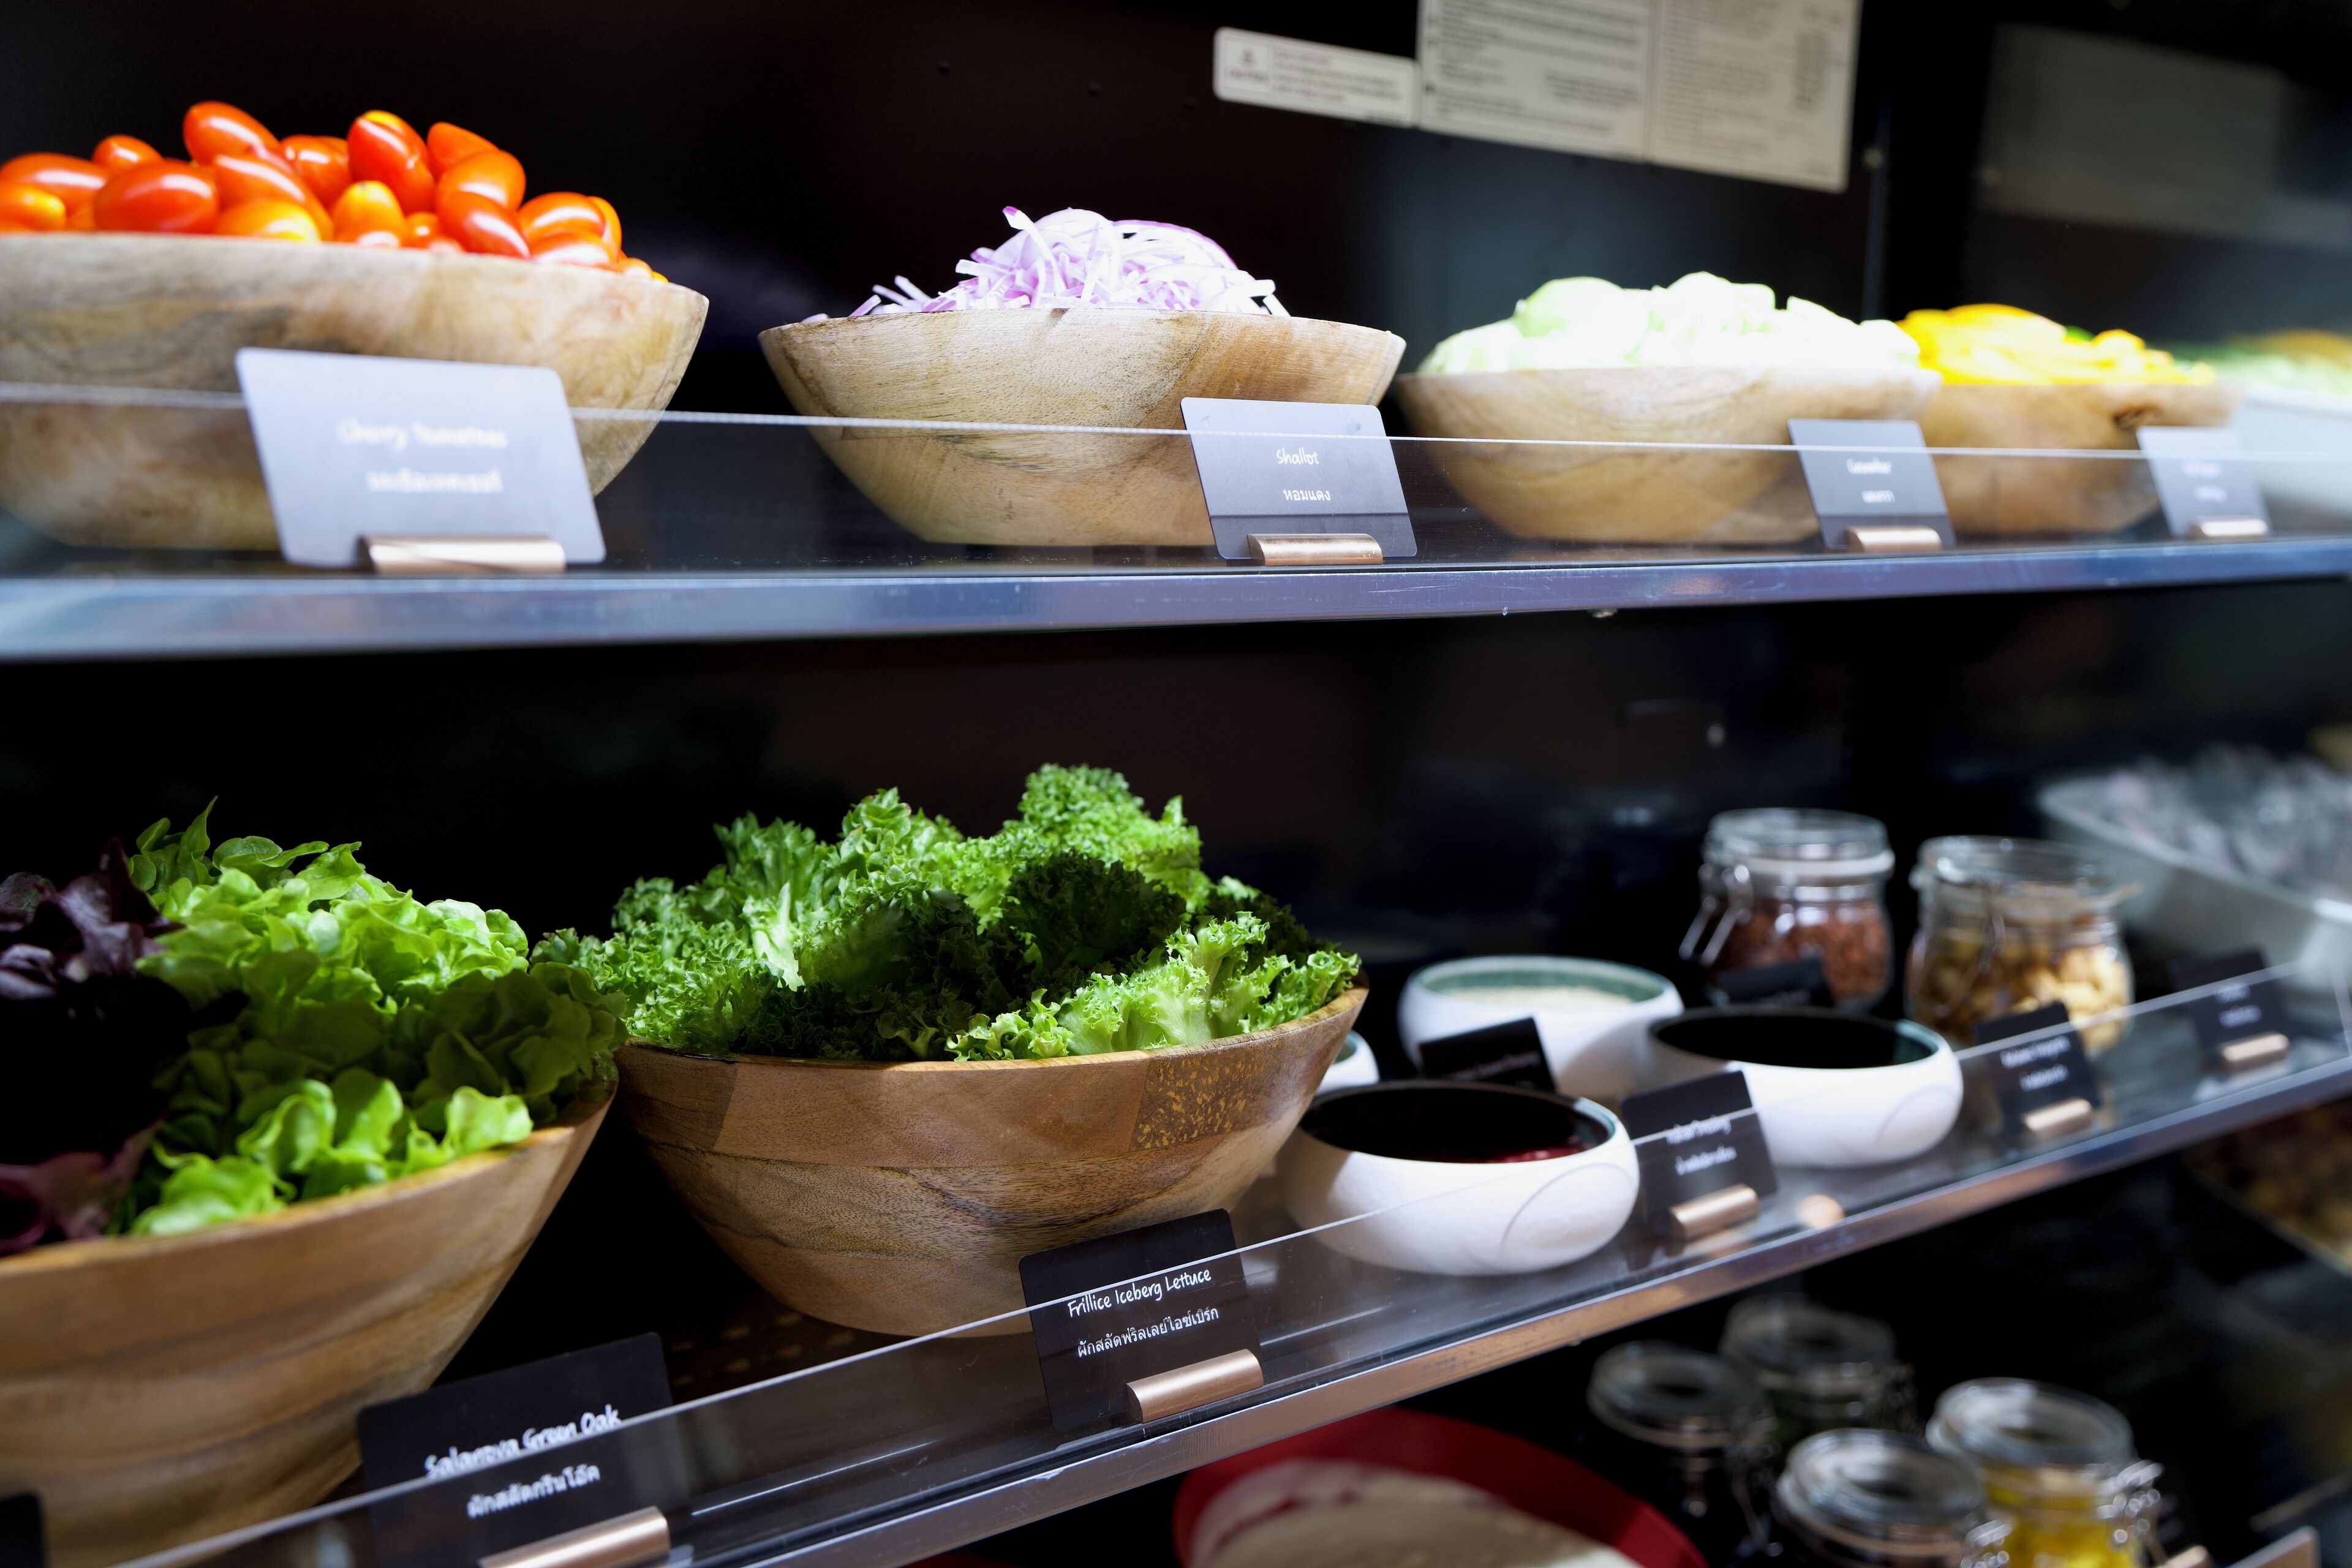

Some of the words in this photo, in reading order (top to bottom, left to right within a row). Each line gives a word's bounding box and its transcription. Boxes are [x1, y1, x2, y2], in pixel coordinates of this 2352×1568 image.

[1276, 447, 1319, 465] Shallot
[1283, 488, 1331, 501] หอมแดง
[1068, 1293, 1112, 1318] Frillice
[1115, 1282, 1163, 1305] Iceberg
[1165, 1269, 1212, 1292] Lettuce
[522, 1422, 578, 1450] Green
[581, 1403, 622, 1434] Oak
